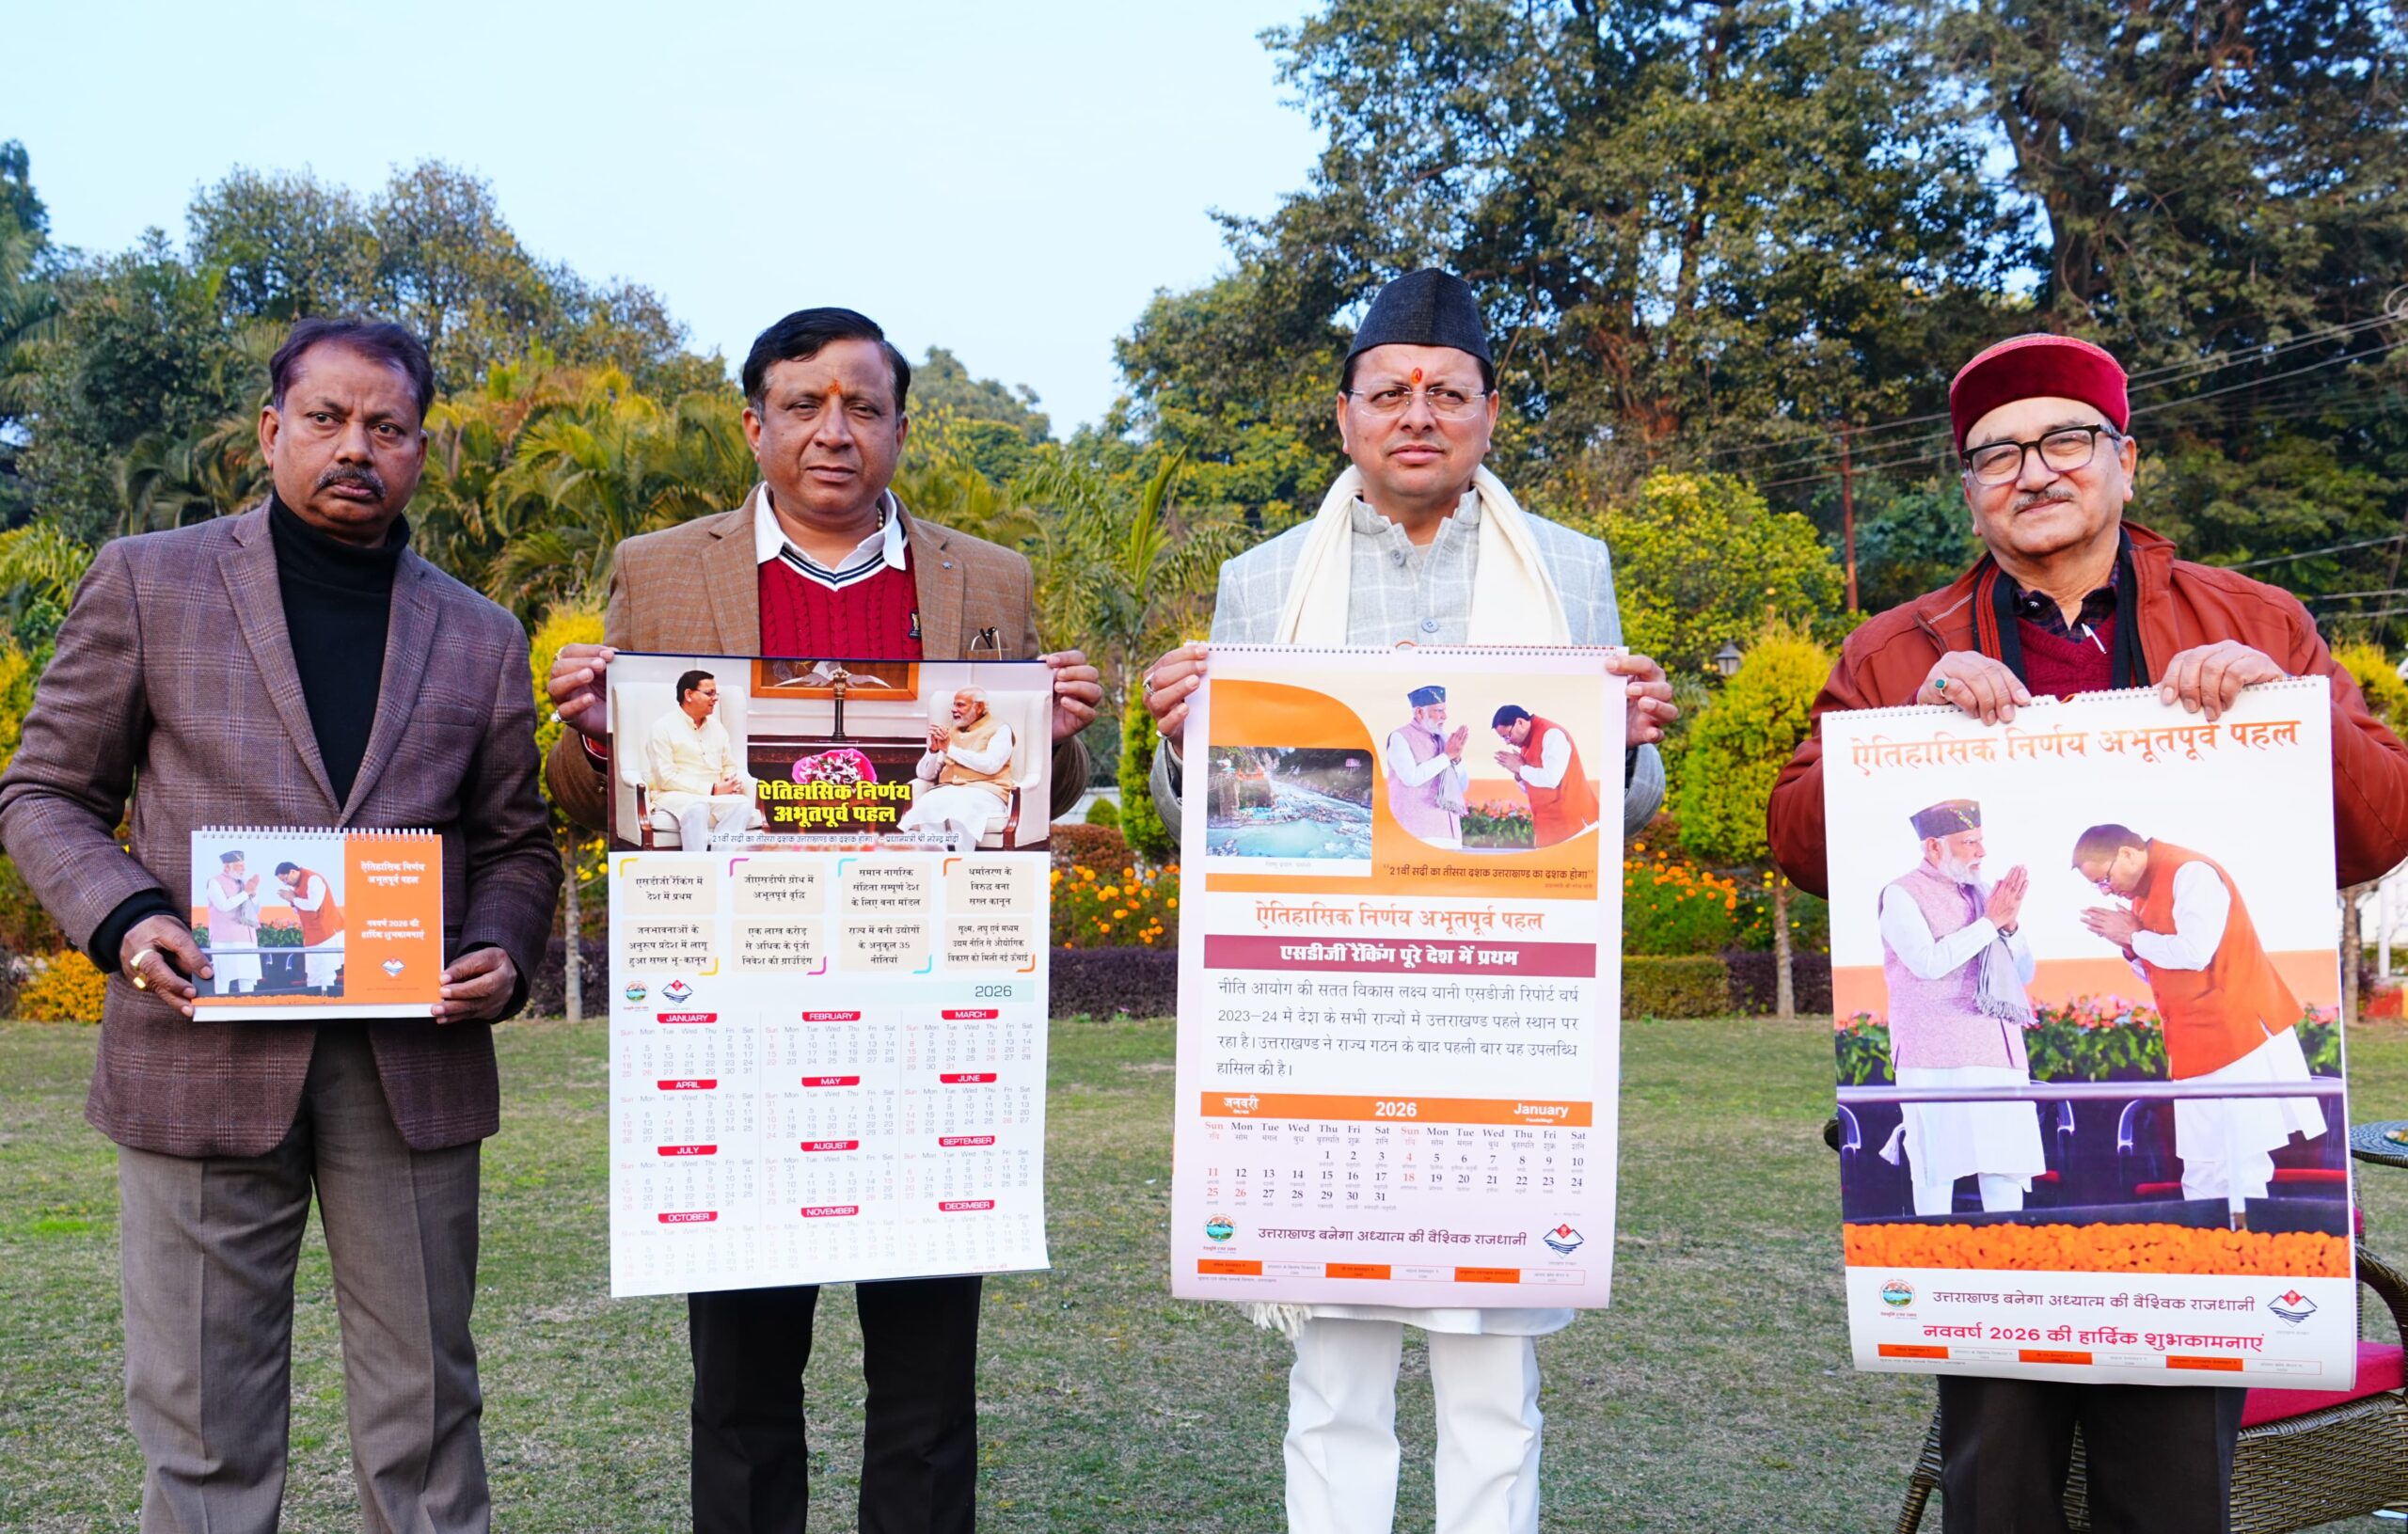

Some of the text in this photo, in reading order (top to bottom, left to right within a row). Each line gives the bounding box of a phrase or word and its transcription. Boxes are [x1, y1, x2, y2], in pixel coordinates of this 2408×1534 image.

[1852, 720, 2303, 777] ऐतिहासिक निर्णय अभूतपूर्व पहल
[758, 779, 911, 800] ऐतिहासिक निर्णय
[773, 801, 895, 828] अभूतपूर्व पहल
[1412, 865, 1428, 876] सदी
[1431, 867, 1441, 877] का
[1443, 865, 1466, 877] तीसरा
[1468, 868, 1491, 878] दशक
[1492, 868, 1530, 878] उत्तराखण्ड
[1532, 869, 1543, 878] का
[1545, 869, 1567, 879] दशक
[1256, 899, 1545, 936] ऐतिहासिक निर्णय अभूतपूर्व पहल
[1279, 941, 1520, 969] एसडीजी रैंकिंग पूरे देश में प्रथम
[974, 985, 1012, 998] 2026
[1218, 977, 1579, 1003] नीति आयोग की सतत विकास लक्ष्य यानी एसडीजी रिपोर्ट वर्ष
[666, 1014, 708, 1023] JANUARY
[809, 1012, 854, 1020] FEBRUARY
[955, 1010, 987, 1019] MARCH
[1282, 1005, 1293, 1023] में
[1297, 1006, 1320, 1025] देश
[1323, 1006, 1337, 1024] के
[1339, 1007, 1368, 1025] सभी
[1370, 1008, 1406, 1026] राज्यों
[1410, 1008, 1421, 1026] में
[1425, 1014, 1489, 1028] उत्तराखण्ड
[1492, 1011, 1521, 1029] पहले
[1525, 1017, 1557, 1030] स्थान
[1560, 1018, 1579, 1031] पर
[1216, 1036, 1238, 1049] रहा
[1258, 1036, 1321, 1051] उत्तराखण्ड
[1322, 1034, 1333, 1051] ने
[1336, 1038, 1367, 1052] राज्य
[1370, 1039, 1399, 1052] गठन
[1402, 1036, 1415, 1052] के
[1417, 1040, 1441, 1053] बाद
[1443, 1037, 1477, 1054] पहली
[1479, 1042, 1503, 1055] बार
[1504, 1043, 1526, 1055] यह
[1527, 1039, 1578, 1057] उपलब्धि
[1216, 1057, 1256, 1075] हासिल
[1258, 1058, 1275, 1076] की
[674, 1080, 701, 1089] APRIL
[820, 1077, 842, 1086] MAY
[957, 1073, 981, 1083] JUNE
[1224, 1095, 1259, 1111] जनवरी
[1375, 1101, 1418, 1117] 2026
[1513, 1102, 1569, 1118] January
[1205, 1121, 1389, 1135] Sun Mon Tue Wed Thu Fri Sat
[1401, 1127, 1586, 1140] Sun Mon Tue Wed Thu Fri Sat
[812, 1141, 848, 1150] AUGUST
[943, 1136, 992, 1147] SEPTEMBER
[676, 1146, 701, 1155] JULY
[1207, 1187, 1386, 1202] 25 26 27 28 29 30 31
[806, 1207, 856, 1216] NOVEMBER
[943, 1201, 990, 1210] DECEMBER
[667, 1212, 710, 1222] OCTOBER
[1258, 1226, 1528, 1246] उत्तराखण्ड बनेगा अध्यात्म की वैश्विक राजधानी
[1932, 1289, 2256, 1312] उत्तराखण्ड बनेगा अध्यात्म की वैश्विक राजधानी
[1922, 1321, 2265, 1352] नववर्ष 2026 की हार्दिक शुभकामनाएं
